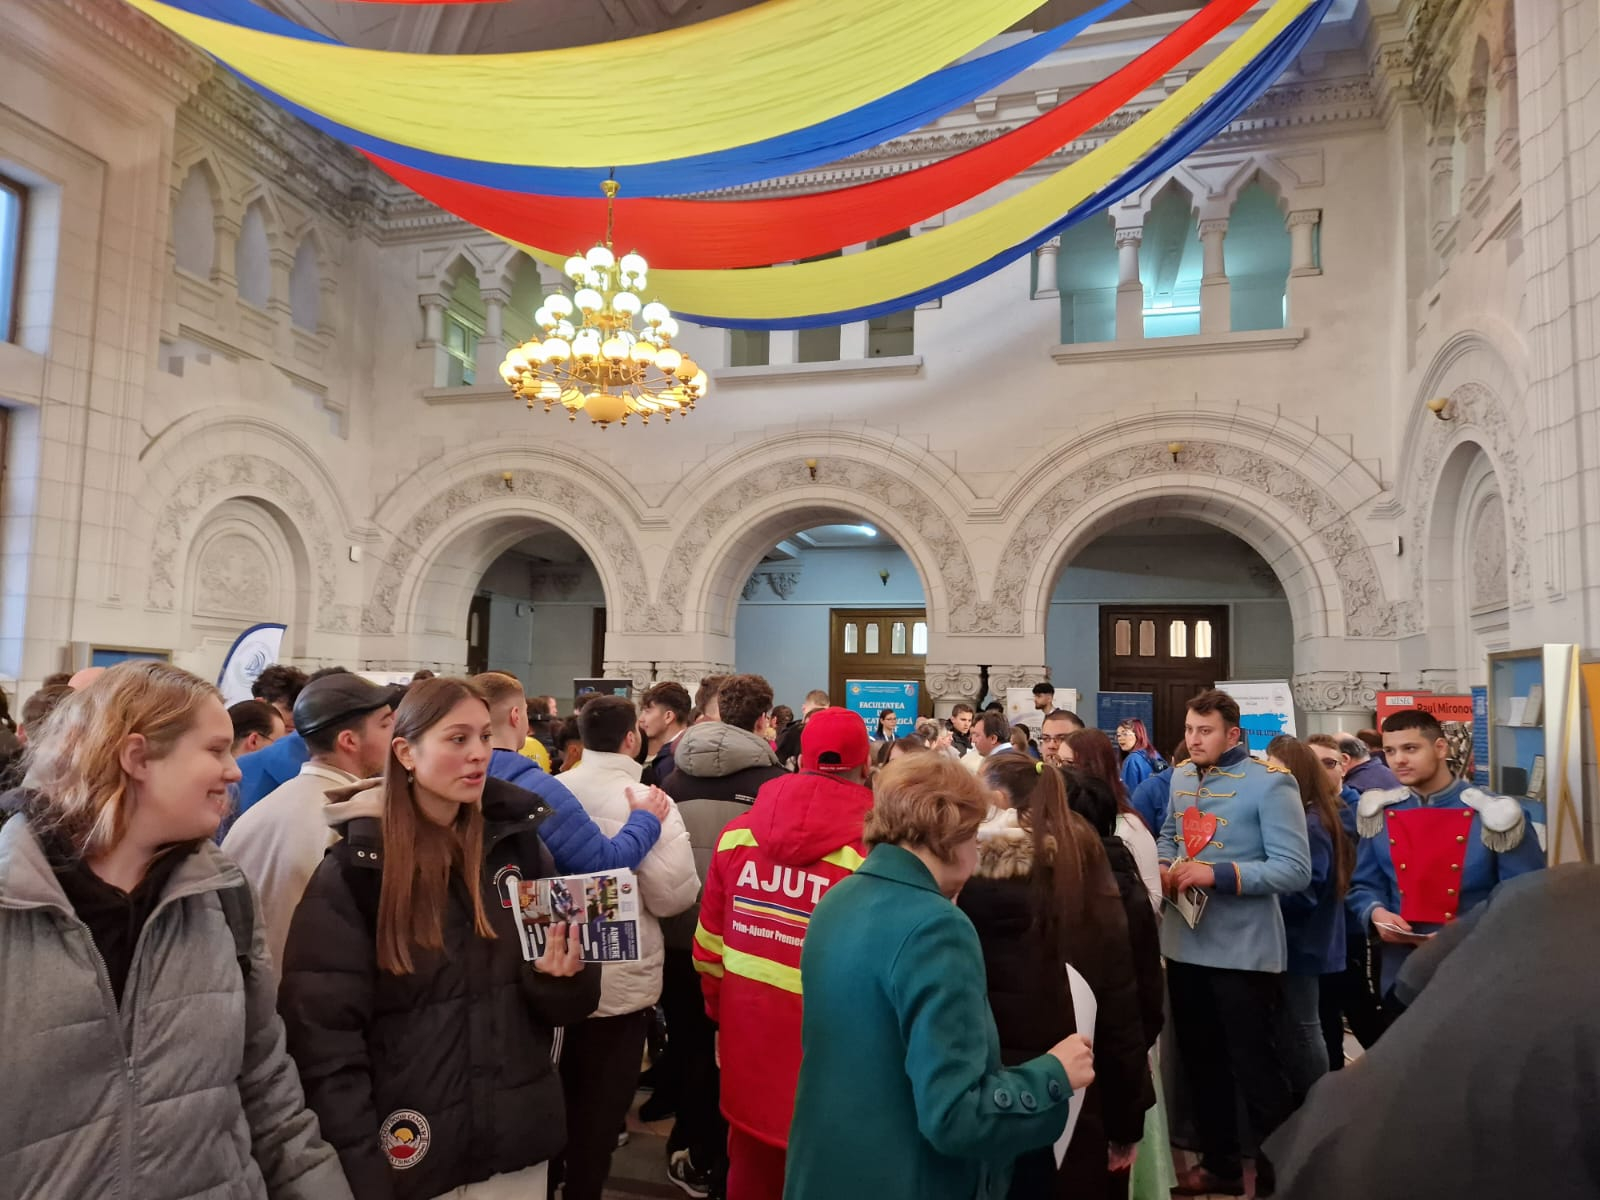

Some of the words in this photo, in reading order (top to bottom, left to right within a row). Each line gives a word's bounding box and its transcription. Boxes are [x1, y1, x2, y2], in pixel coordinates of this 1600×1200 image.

[1417, 703, 1436, 713] Paul
[736, 860, 830, 905] AJUT
[732, 920, 774, 939] Prim-Ajutor
